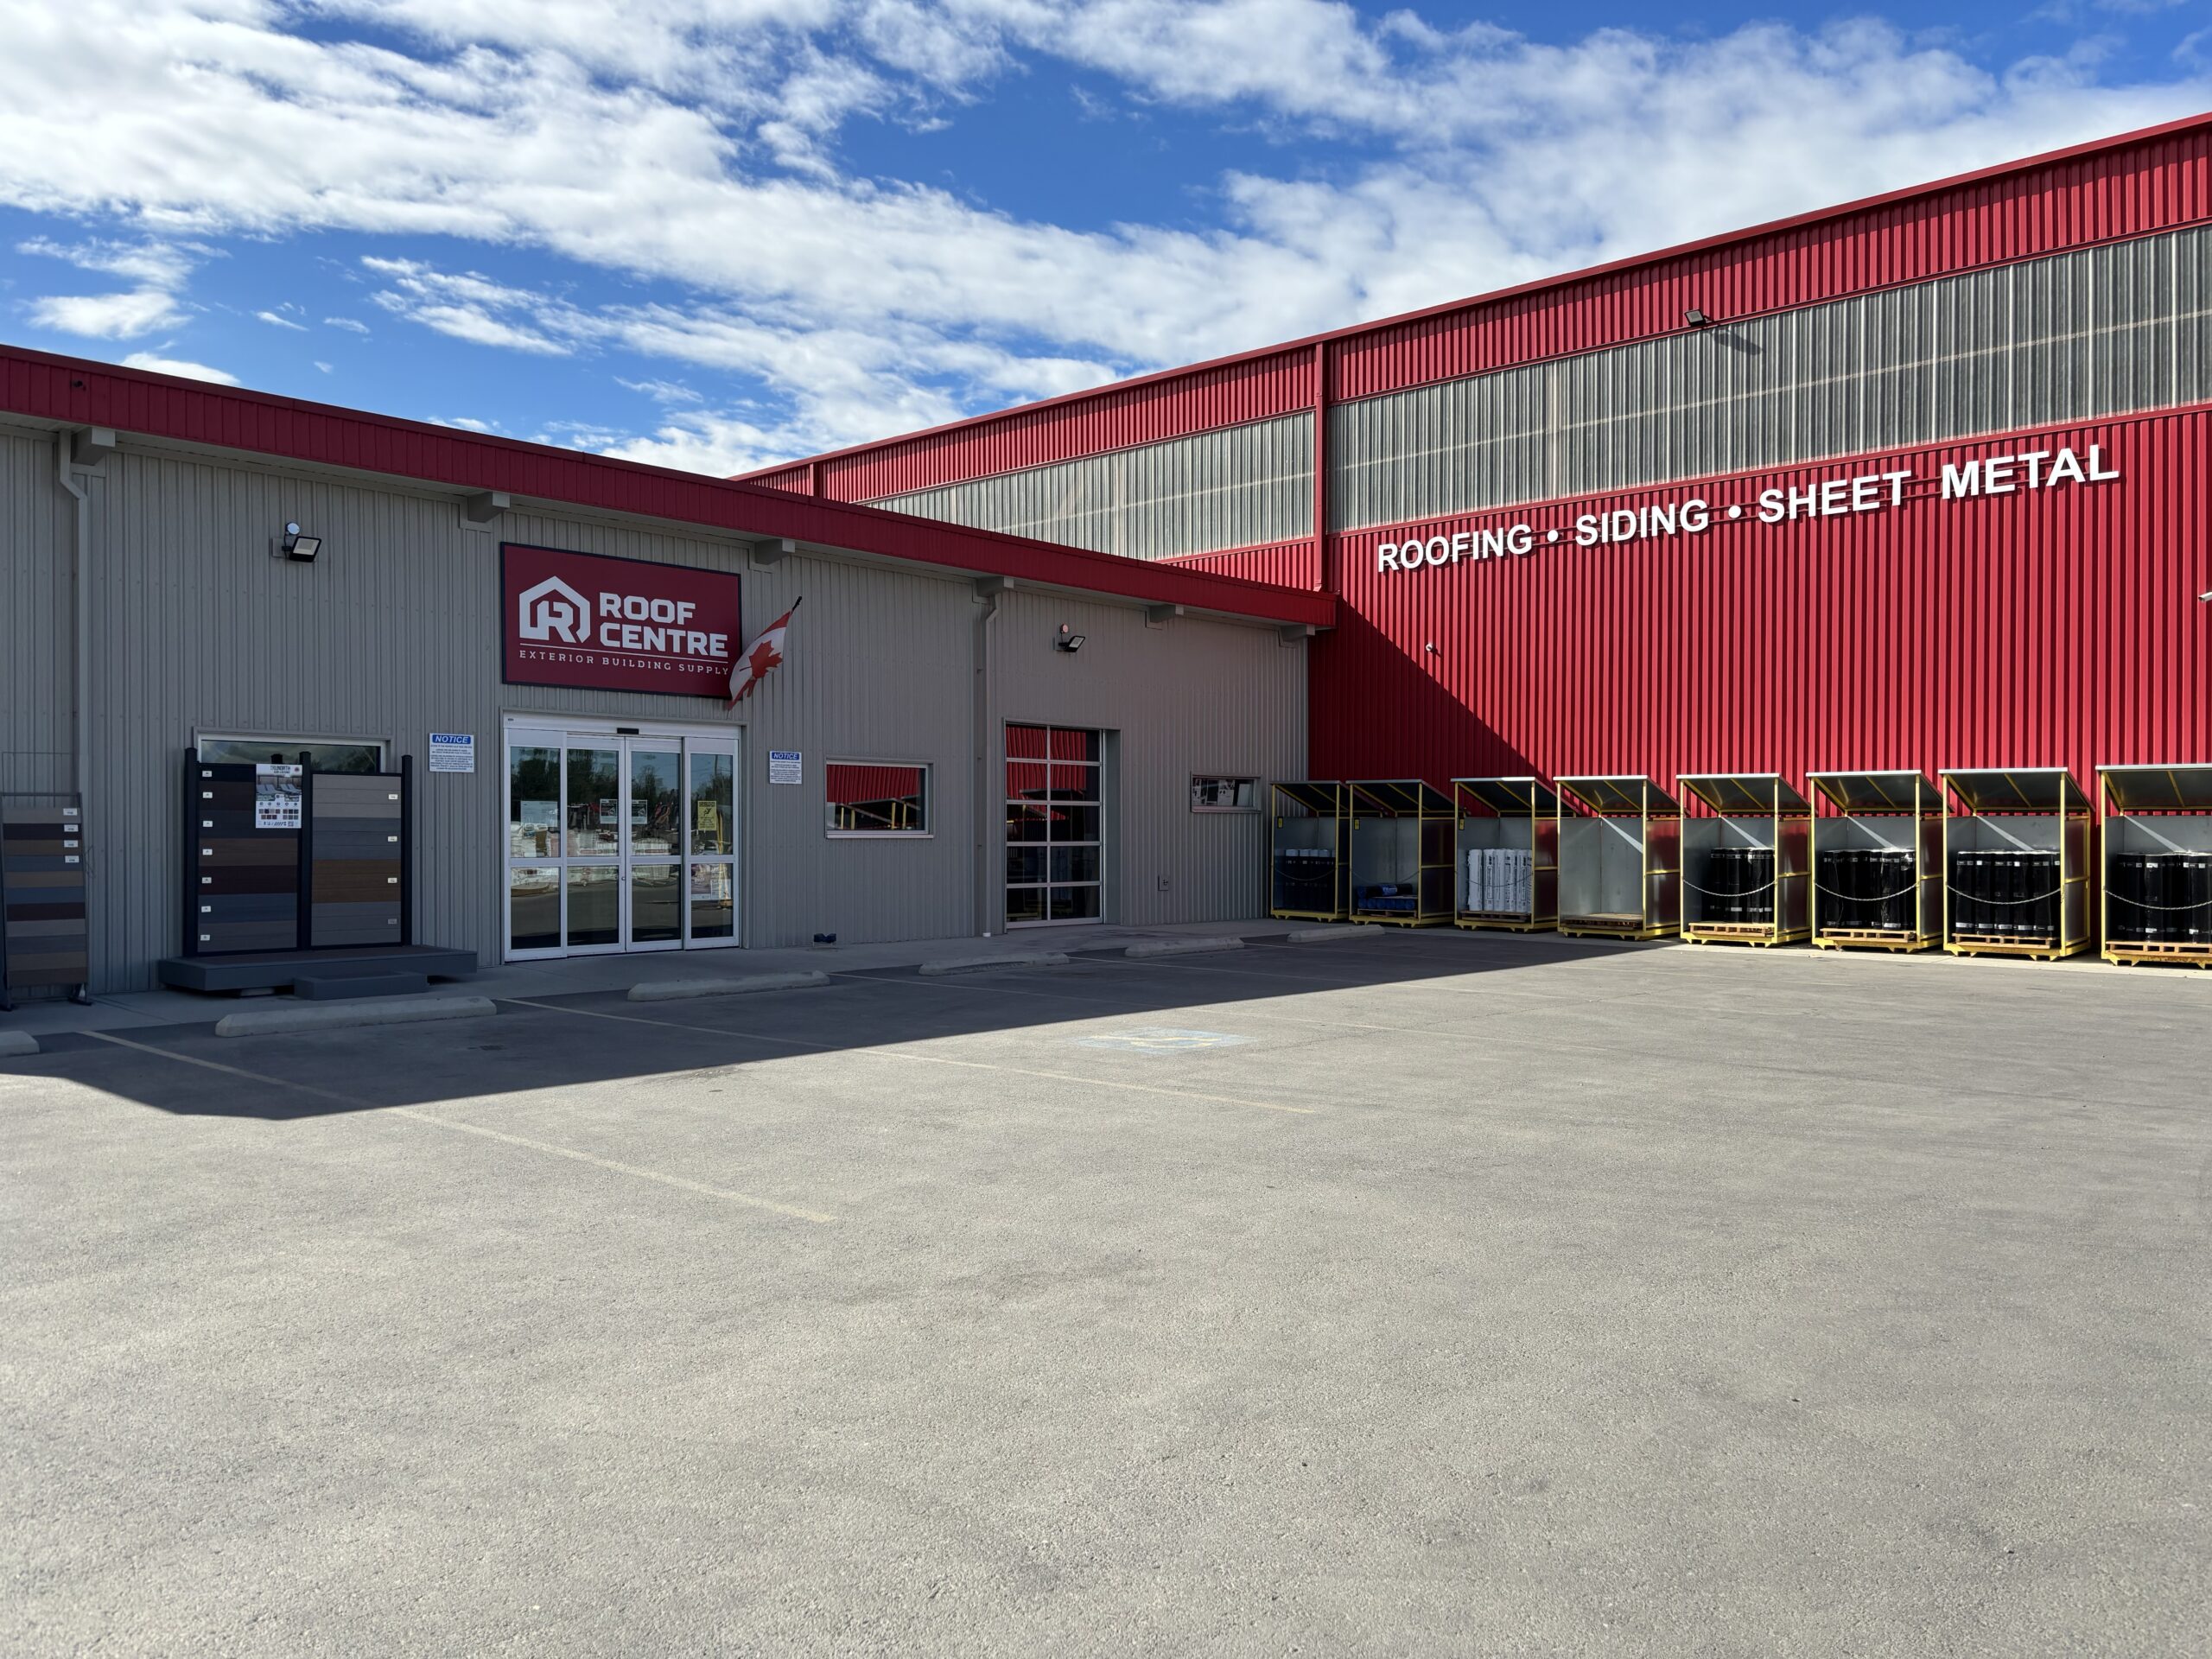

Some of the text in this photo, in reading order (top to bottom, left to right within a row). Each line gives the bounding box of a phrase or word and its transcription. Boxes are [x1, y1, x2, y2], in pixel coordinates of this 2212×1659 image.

[1378, 444, 2120, 572] ROOFING SIDING SHEET METAL
[599, 592, 696, 626] ROOF
[600, 623, 728, 658] CENTRE
[519, 650, 729, 676] EXTERIOR BUILDING SUPPLY
[435, 734, 469, 744] NOTICE
